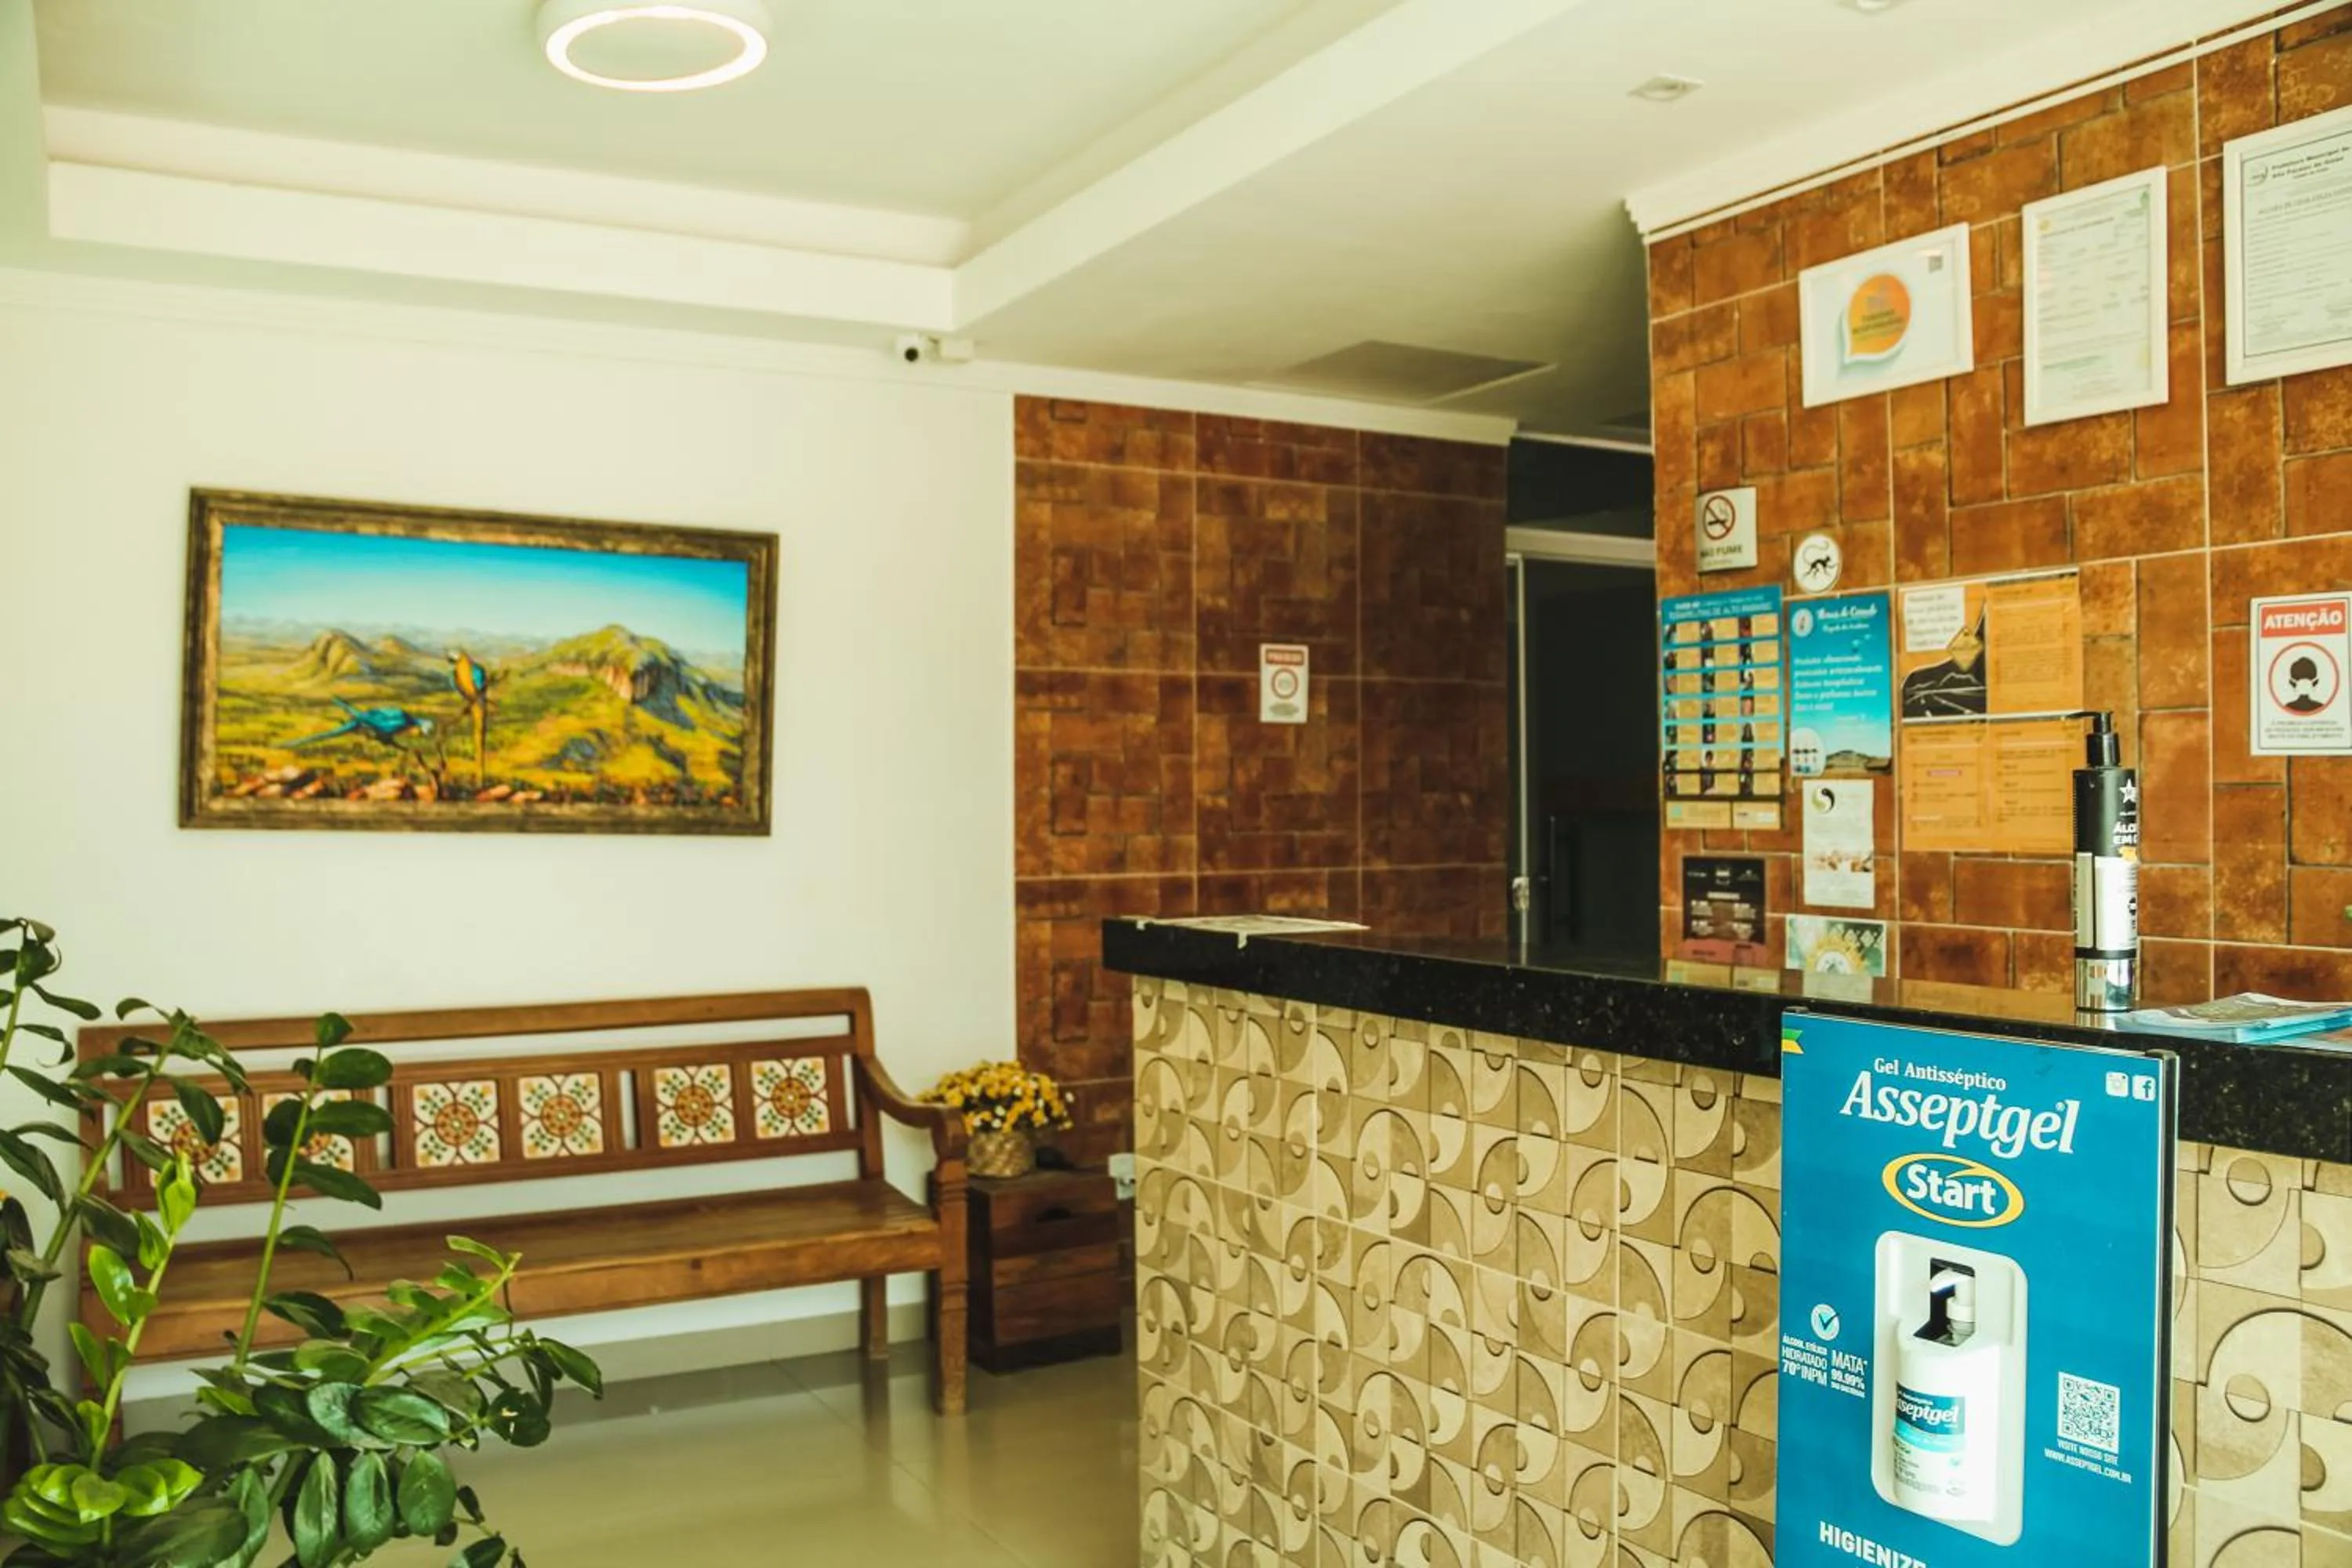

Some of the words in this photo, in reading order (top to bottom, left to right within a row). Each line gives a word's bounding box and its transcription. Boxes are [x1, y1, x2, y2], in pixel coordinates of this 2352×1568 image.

[2263, 607, 2343, 631] ATENÇÃO
[1874, 1058, 1899, 1075] Gel
[1904, 1062, 2007, 1091] Antisséptico
[1840, 1070, 2081, 1159] Asseptgel
[1907, 1163, 1997, 1215] Start
[1782, 1345, 1828, 1370] HIDRATADO
[1801, 1365, 1828, 1387] INPM
